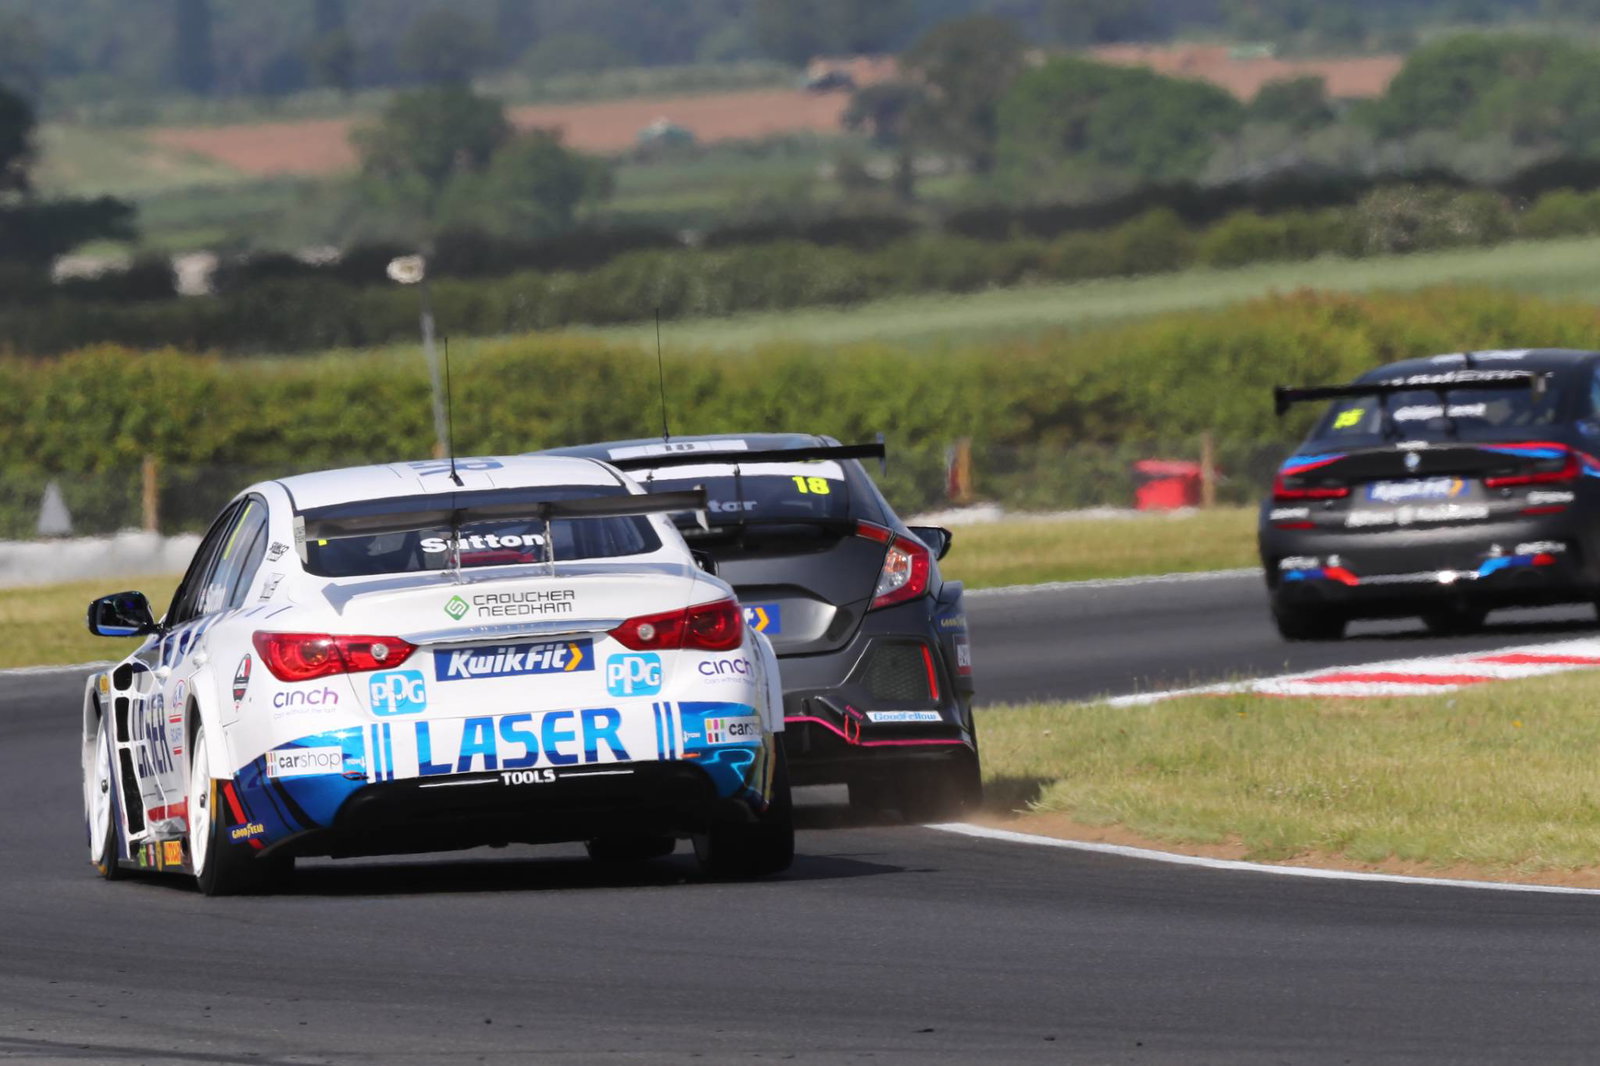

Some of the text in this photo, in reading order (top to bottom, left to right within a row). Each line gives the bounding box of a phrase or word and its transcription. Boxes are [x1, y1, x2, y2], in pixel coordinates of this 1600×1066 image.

[792, 476, 830, 495] 18
[420, 533, 546, 553] Sutton
[472, 589, 575, 605] CROUCHER
[478, 602, 573, 617] NEEDHAM
[608, 656, 662, 694] PPG
[698, 657, 755, 676] cinch
[273, 687, 339, 708] cinch
[371, 673, 425, 712] PPG
[415, 708, 633, 776] LASER
[279, 752, 341, 769] carshop
[501, 770, 556, 786] TOOLS
[232, 822, 264, 839] GOODYEAR
